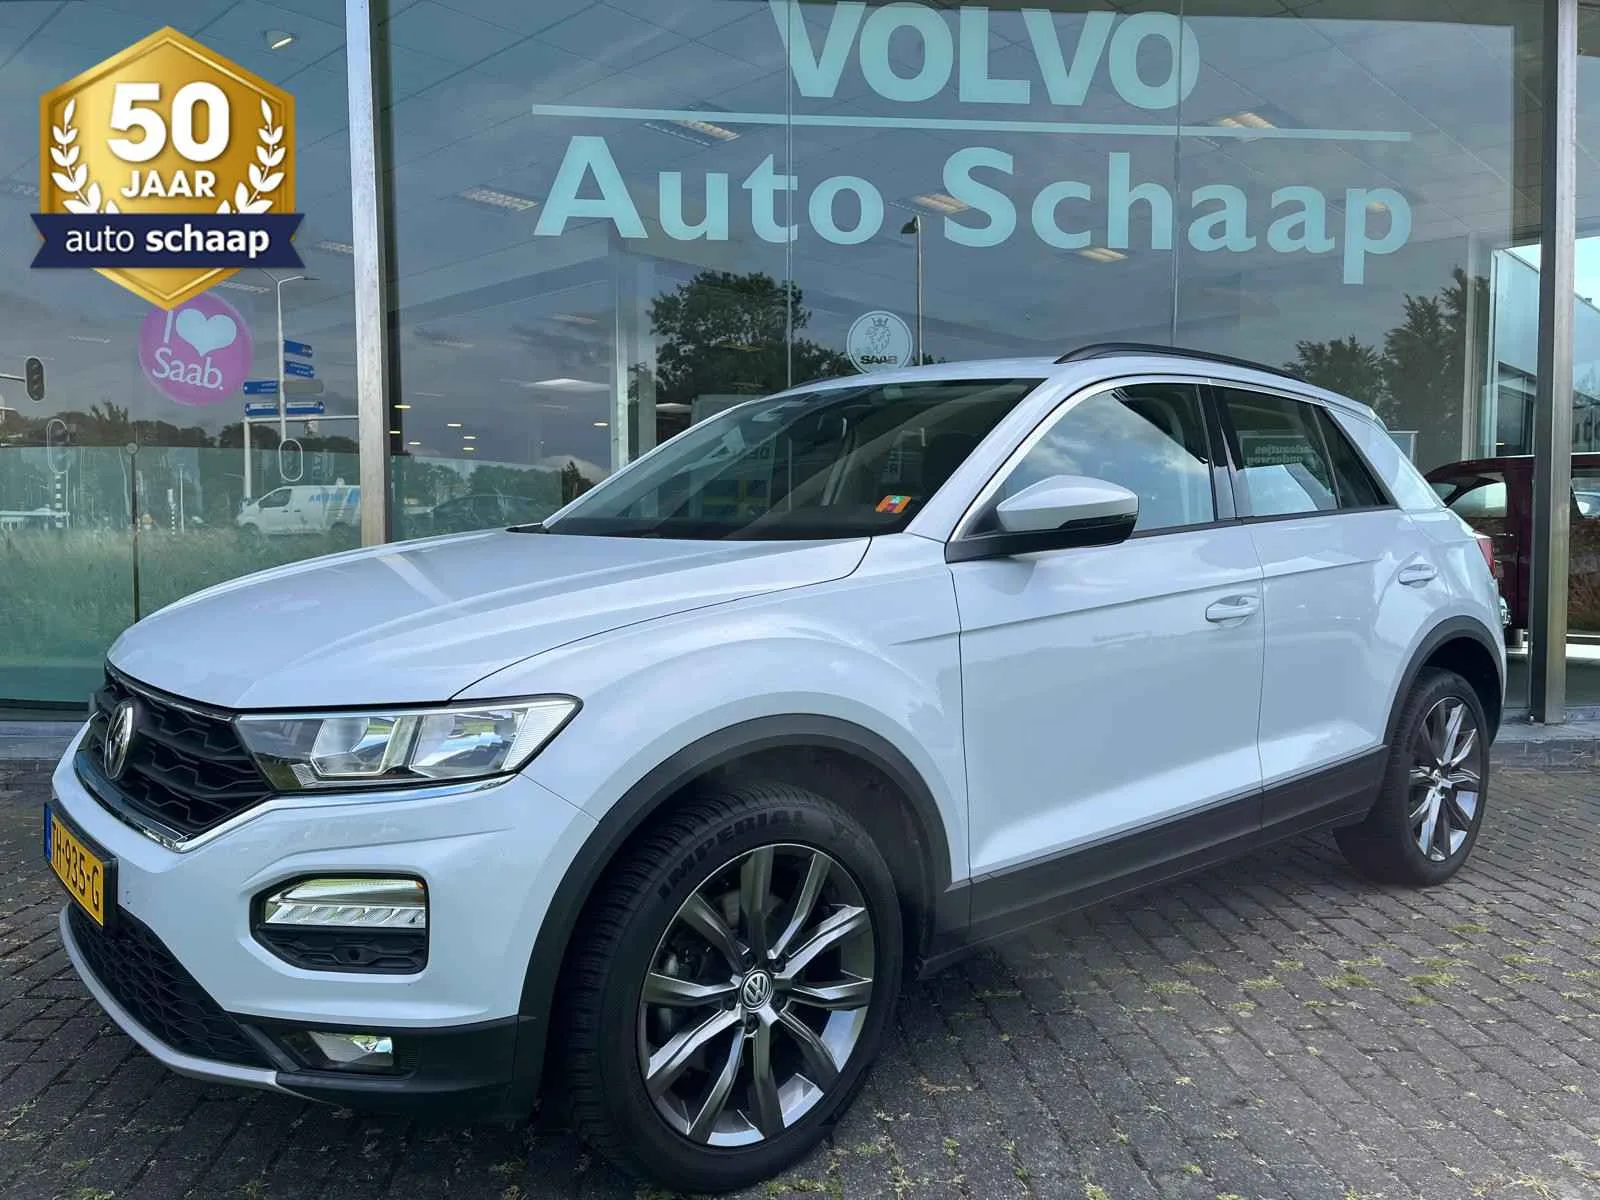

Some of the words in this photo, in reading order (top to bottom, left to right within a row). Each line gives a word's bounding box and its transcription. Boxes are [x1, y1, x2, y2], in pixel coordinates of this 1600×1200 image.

[769, 0, 1199, 109] VOLVO
[533, 136, 884, 244] Auto
[942, 147, 1413, 284] Schaap
